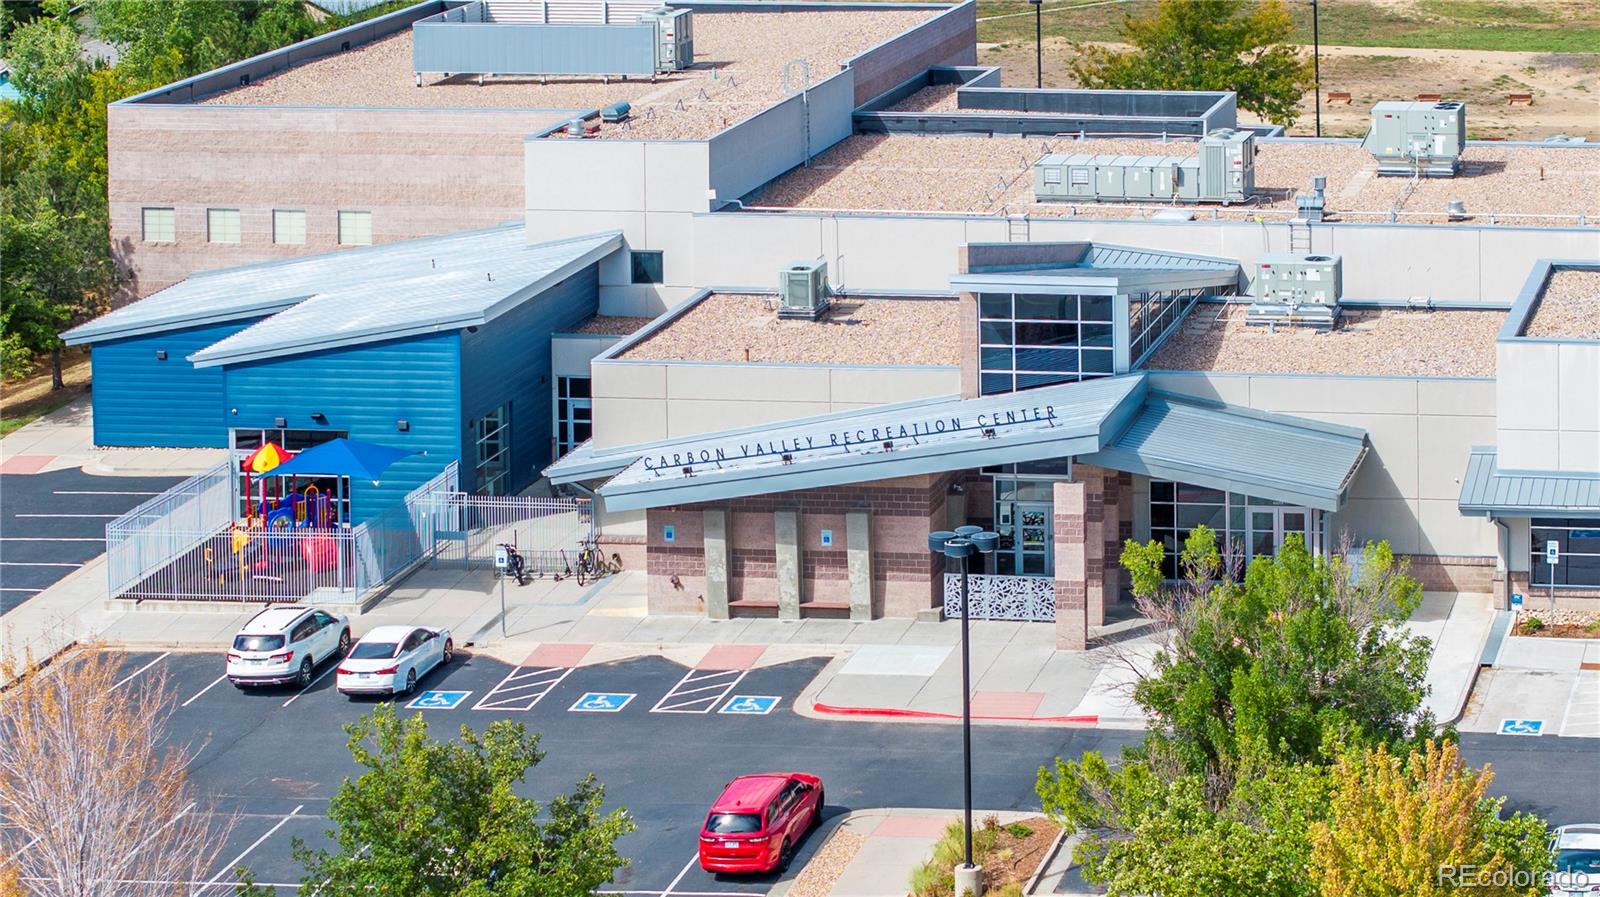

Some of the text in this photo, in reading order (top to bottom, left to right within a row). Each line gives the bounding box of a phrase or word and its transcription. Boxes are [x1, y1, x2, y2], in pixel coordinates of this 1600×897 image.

[644, 405, 1056, 470] CARBON VALLEY RECREATION CENTER
